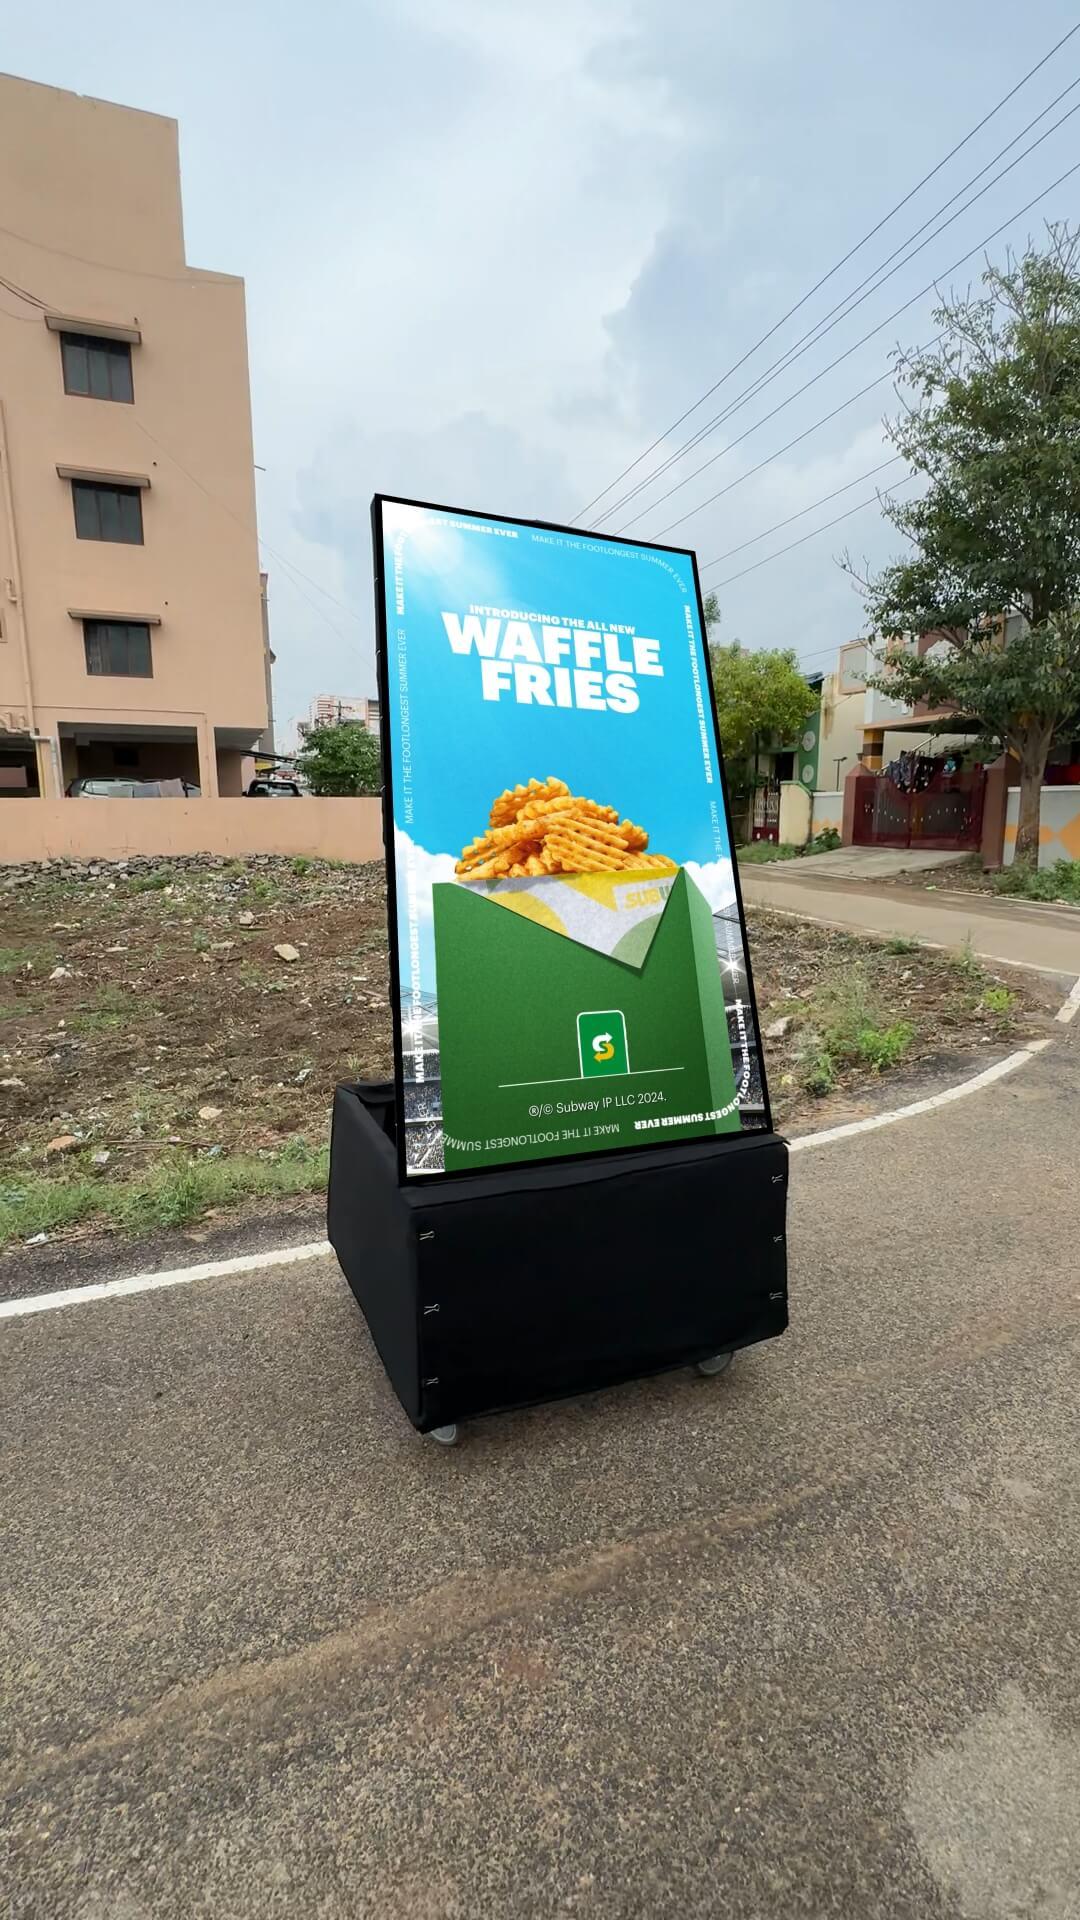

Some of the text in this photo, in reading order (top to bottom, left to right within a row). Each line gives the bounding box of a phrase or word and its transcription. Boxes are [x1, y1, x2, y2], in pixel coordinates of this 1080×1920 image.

[449, 520, 493, 534] SUMMER
[493, 527, 519, 539] EVER
[531, 534, 688, 593] MAKE IT THE FOOTLONGEST SUMMER EVER
[395, 576, 404, 587] IT
[396, 586, 405, 616] MAKE
[469, 604, 636, 635] INTRODUCING THE ALL NEW
[441, 611, 665, 677] WAFFLE
[481, 658, 641, 714] FRIES
[684, 605, 713, 785] MAKE IT THE FOOTLONGEST SUMMER EVER
[397, 629, 414, 824] MAKE IT THE FOOTLONGEST SUMMER EVER
[710, 800, 719, 825] MAKE
[409, 922, 422, 1008] FOOTLONGEST
[415, 1033, 424, 1045] IT
[415, 1047, 425, 1084] MAKE
[633, 998, 751, 1130] MAKE IT THE FOOTLONGEST SUMMER EVER
[556, 1100, 600, 1114] Subway
[602, 1097, 613, 1108] IP
[615, 1094, 636, 1107] LLC
[484, 1129, 560, 1151] FOOTLONGEST
[561, 1128, 581, 1141] THE
[582, 1126, 591, 1138] IT
[591, 1122, 620, 1136] MAKE
